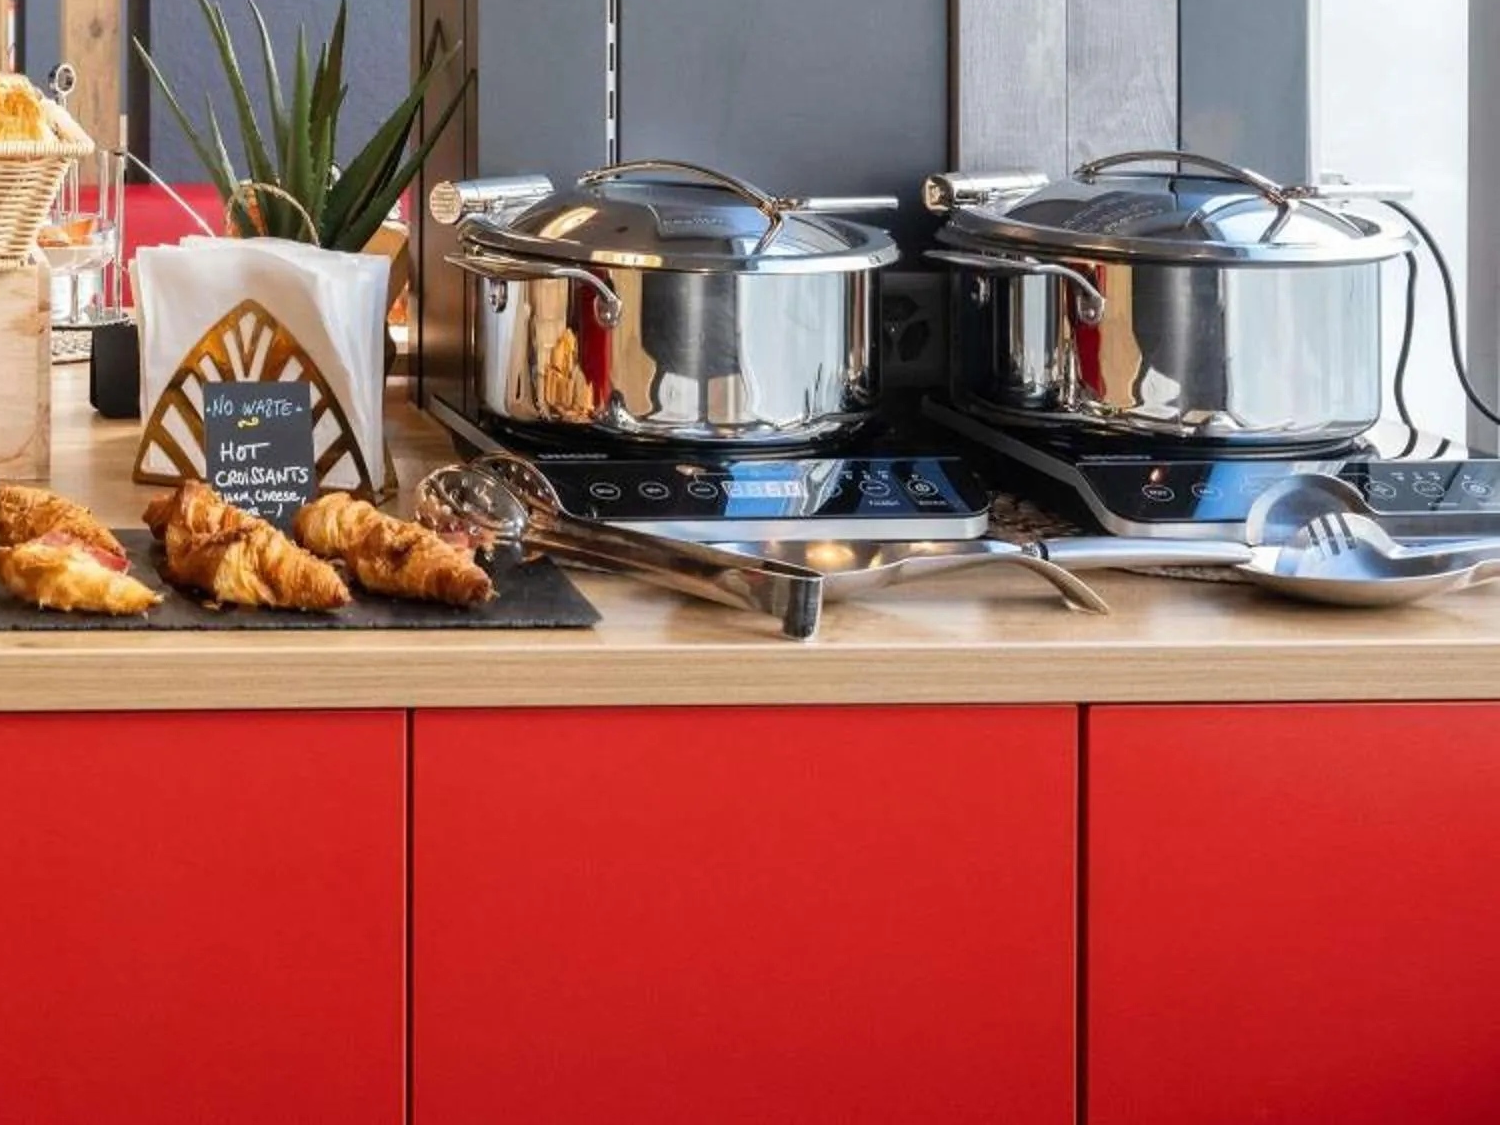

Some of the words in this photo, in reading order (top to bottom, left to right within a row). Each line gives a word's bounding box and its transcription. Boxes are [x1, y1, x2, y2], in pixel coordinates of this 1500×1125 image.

[211, 393, 235, 419] NO
[242, 397, 294, 419] WASTE
[219, 440, 272, 463] HOT
[214, 465, 310, 488] CROISSANTS
